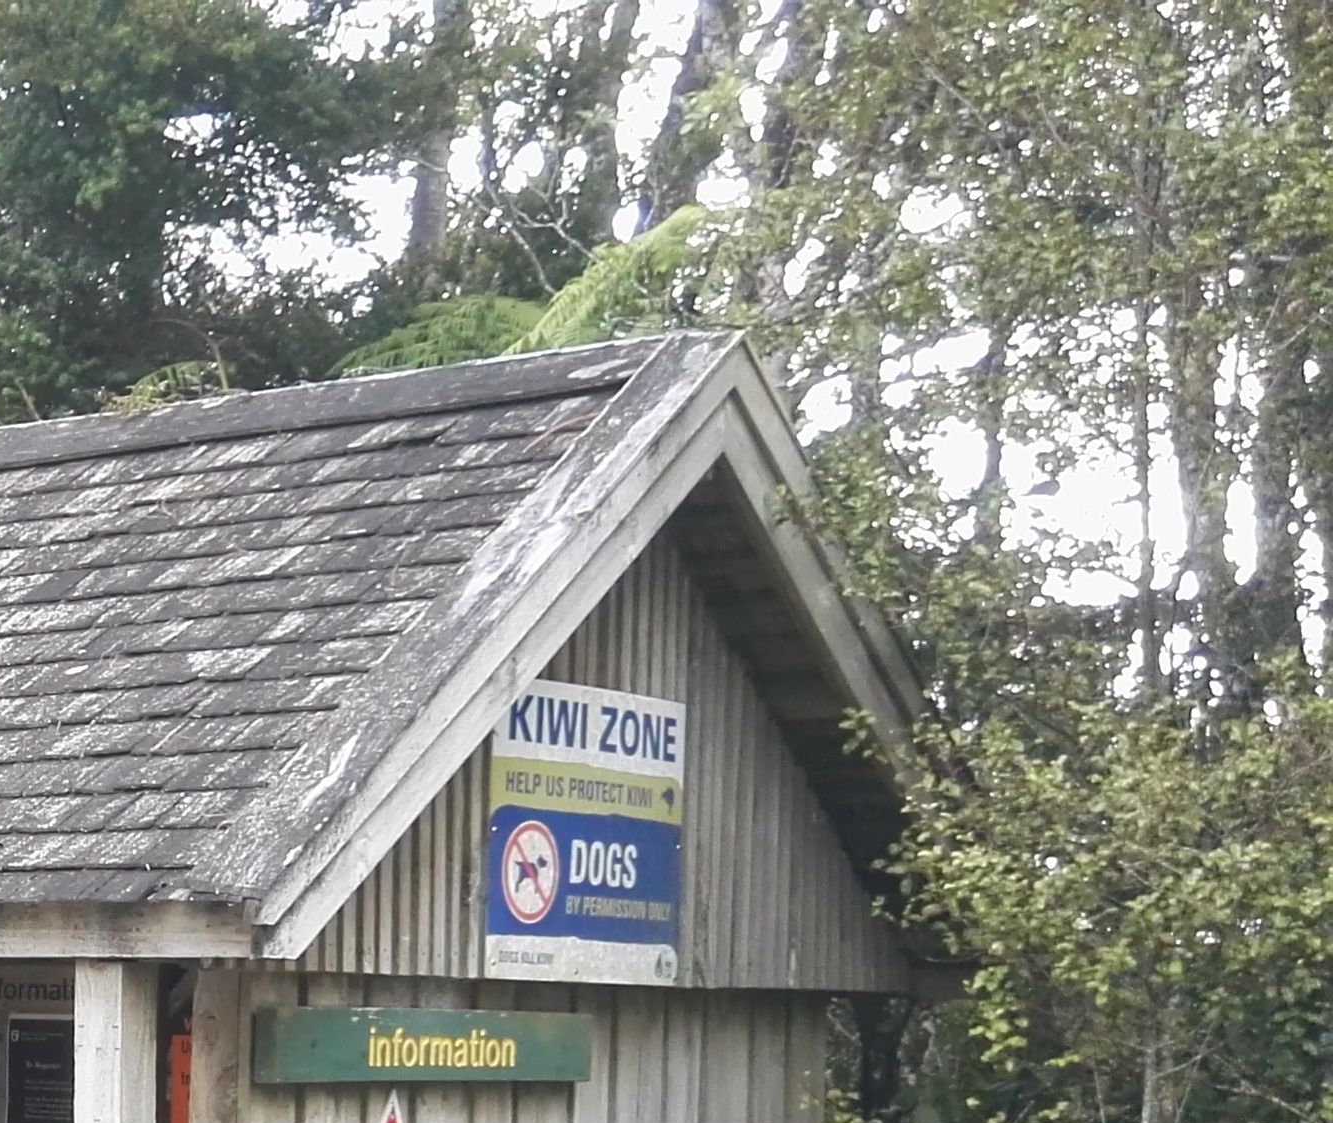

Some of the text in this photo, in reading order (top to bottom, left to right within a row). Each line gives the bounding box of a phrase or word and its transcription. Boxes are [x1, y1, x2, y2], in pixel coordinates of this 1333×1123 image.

[508, 694, 677, 763] KIWI ZONE
[505, 770, 542, 795] HELP
[545, 776, 564, 797] US
[568, 779, 624, 804] PROTECT
[569, 839, 638, 889] DOGS
[565, 895, 581, 916] BY
[367, 1026, 517, 1068] information
